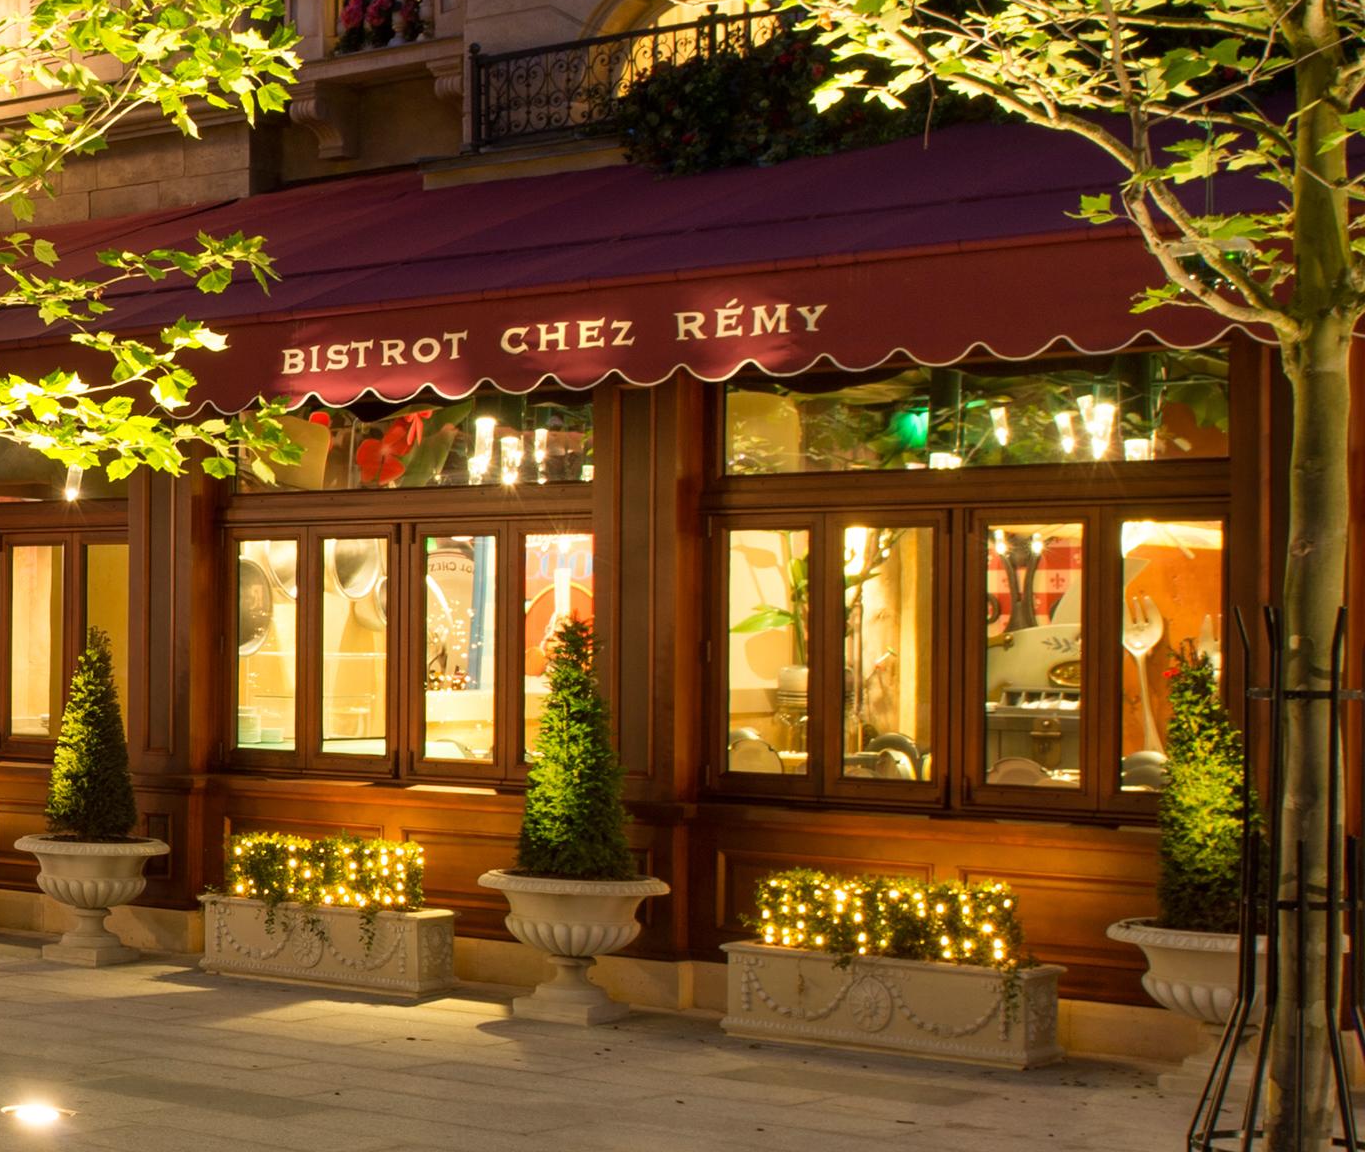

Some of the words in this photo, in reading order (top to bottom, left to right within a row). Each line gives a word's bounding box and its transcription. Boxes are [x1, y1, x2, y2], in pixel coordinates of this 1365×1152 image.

[281, 330, 469, 375] BISTROT
[500, 317, 636, 355] CHEZ
[673, 298, 829, 342] RÉMY
